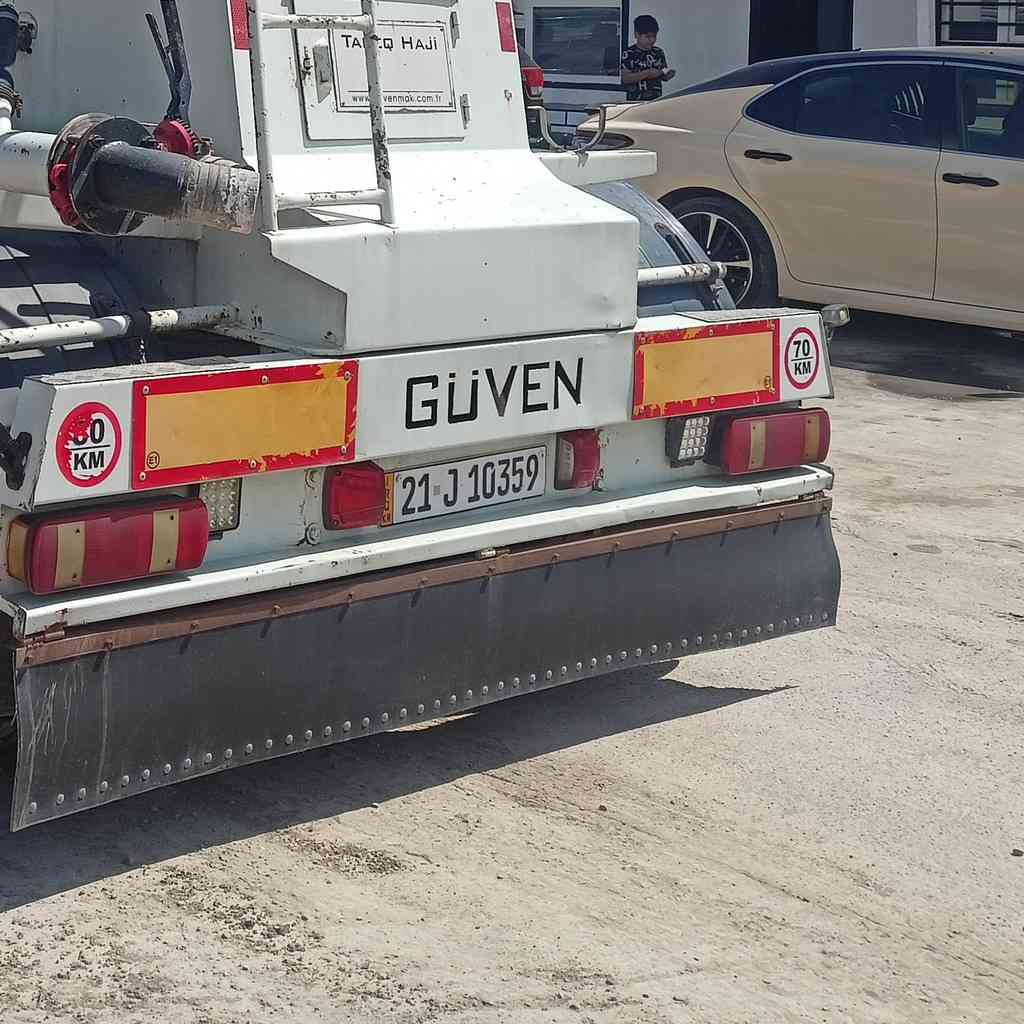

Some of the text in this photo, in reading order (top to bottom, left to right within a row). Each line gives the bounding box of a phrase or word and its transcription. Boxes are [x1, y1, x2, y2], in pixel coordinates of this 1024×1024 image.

[341, 34, 393, 52] TAQ
[793, 339, 810, 357] 70
[794, 361, 811, 375] KM
[405, 357, 583, 429] GÜVEN
[73, 451, 105, 470] KM
[401, 473, 432, 516] 21
[443, 468, 458, 507] J
[467, 453, 539, 504] 10359
